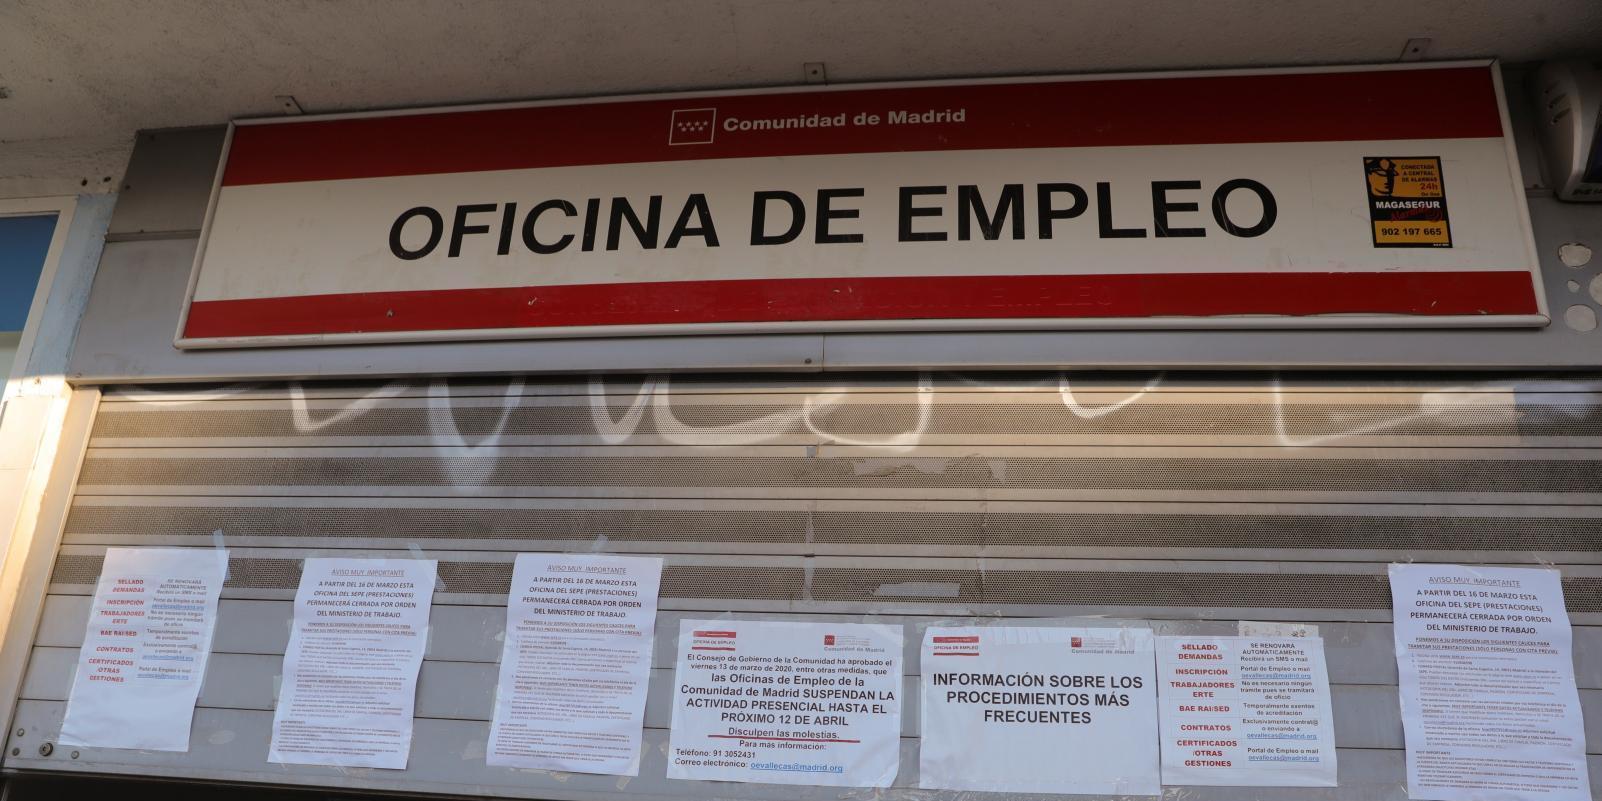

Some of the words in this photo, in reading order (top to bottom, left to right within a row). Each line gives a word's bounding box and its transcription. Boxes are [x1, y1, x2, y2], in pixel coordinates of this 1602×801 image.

[723, 113, 846, 132] Comunidad
[854, 112, 880, 125] de
[888, 109, 966, 124] Madrid
[389, 194, 719, 260] OFICINA
[749, 188, 864, 246] DE
[898, 178, 1278, 241] EMPLEO
[1474, 578, 1520, 587] IMPORTANTE
[586, 589, 637, 597] (PRESTACIONES)
[1491, 592, 1518, 600] MARZO
[1484, 602, 1543, 613] (PRESTACIONES)
[696, 654, 726, 663] Consejo
[847, 659, 884, 667] aprobado
[712, 673, 726, 682] las
[730, 674, 774, 684] Oficinas
[777, 675, 790, 684] de
[794, 676, 834, 687] Empleo
[838, 677, 852, 686] de
[855, 678, 864, 686] la
[933, 672, 1044, 687] INFORMACIÓN
[1050, 676, 1105, 688] SOBRE
[1110, 677, 1142, 689] LOS
[681, 685, 742, 695] Comunidad
[745, 687, 759, 696] de
[762, 688, 799, 697] Madrid
[803, 689, 875, 700] SUSPENDAN
[879, 690, 894, 701] LA
[947, 691, 1090, 706] PROCEDIMIENTOS
[1095, 691, 1130, 706] MÁS
[686, 698, 748, 709] ACTIVIDAD
[751, 700, 824, 712] PRESENCIAL
[829, 702, 868, 712] HASTA
[872, 704, 887, 714] EL
[721, 711, 774, 723] PRÓXIMO
[779, 714, 791, 724] 12
[795, 715, 810, 724] DE
[814, 715, 848, 726] ABRIL
[984, 710, 1091, 724] FRECUENTES
[728, 727, 774, 738] Disculpen
[776, 729, 789, 737] las
[793, 730, 839, 738] molestias.
[739, 740, 757, 748] Para
[675, 758, 701, 766] Correo
[751, 762, 843, 773] oevallecas@madrid.org
